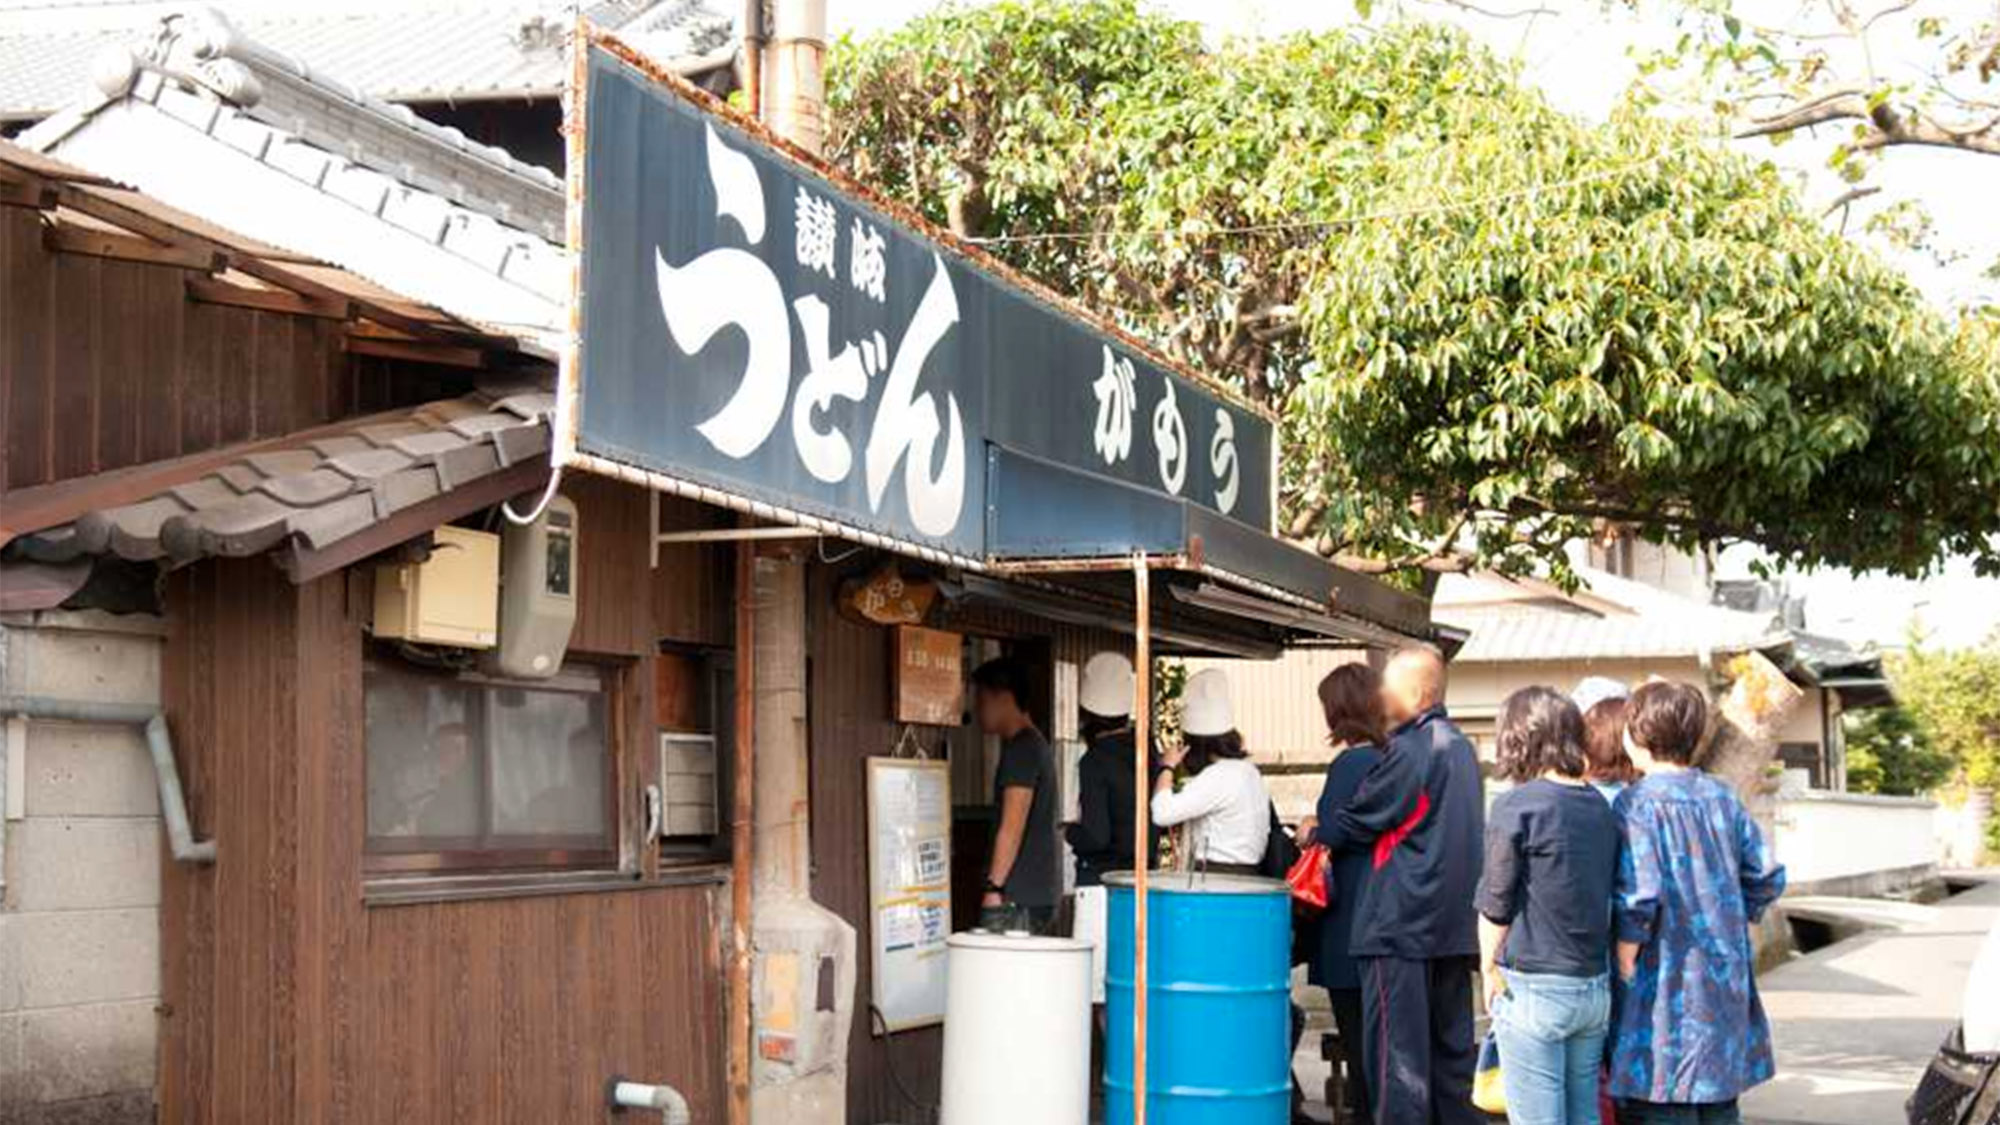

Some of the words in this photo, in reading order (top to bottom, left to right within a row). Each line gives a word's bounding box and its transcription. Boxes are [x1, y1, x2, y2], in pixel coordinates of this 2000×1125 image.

[656, 121, 966, 537] うどん
[1093, 344, 1240, 515] がもう
